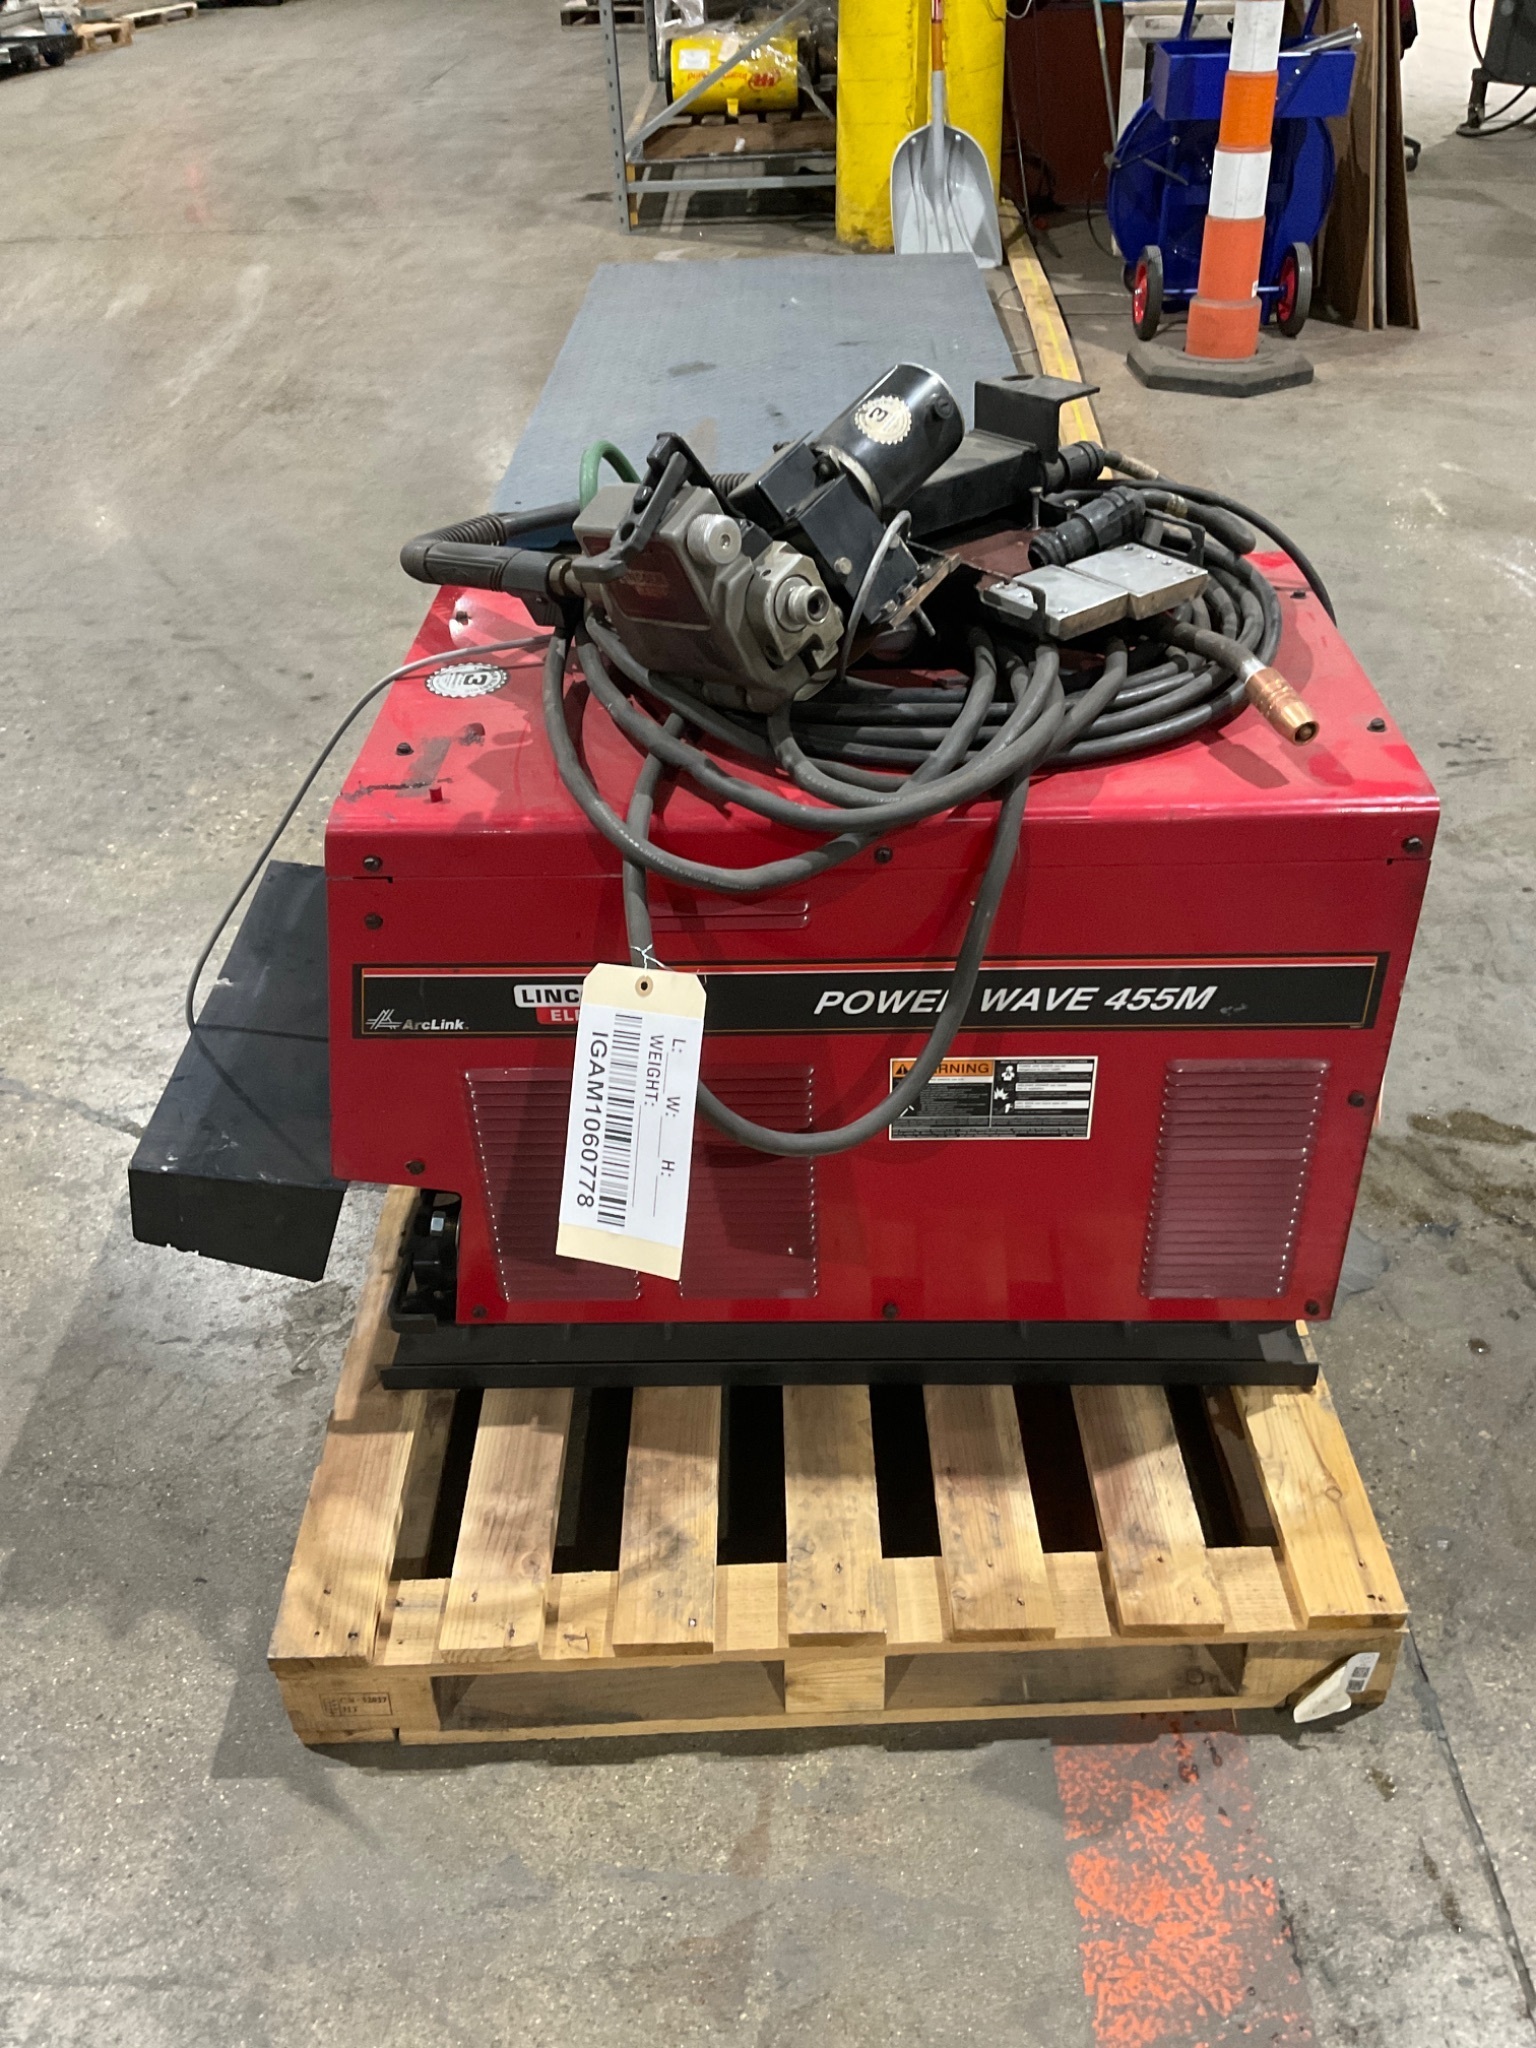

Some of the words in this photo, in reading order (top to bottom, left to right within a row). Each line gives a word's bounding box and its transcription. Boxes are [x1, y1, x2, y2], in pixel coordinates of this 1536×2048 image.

[521, 988, 582, 1004] LINC
[813, 988, 950, 1015] POWE
[980, 986, 1100, 1012] WAVE
[1104, 984, 1218, 1011] 455M
[401, 1018, 465, 1031] ArcLink
[671, 1038, 687, 1053] L:
[644, 1034, 665, 1108] WEIGHT:
[934, 1063, 990, 1074] RNING
[665, 1096, 681, 1118] W:
[577, 1031, 609, 1208] IGAM1060778
[660, 1159, 676, 1178] H:
